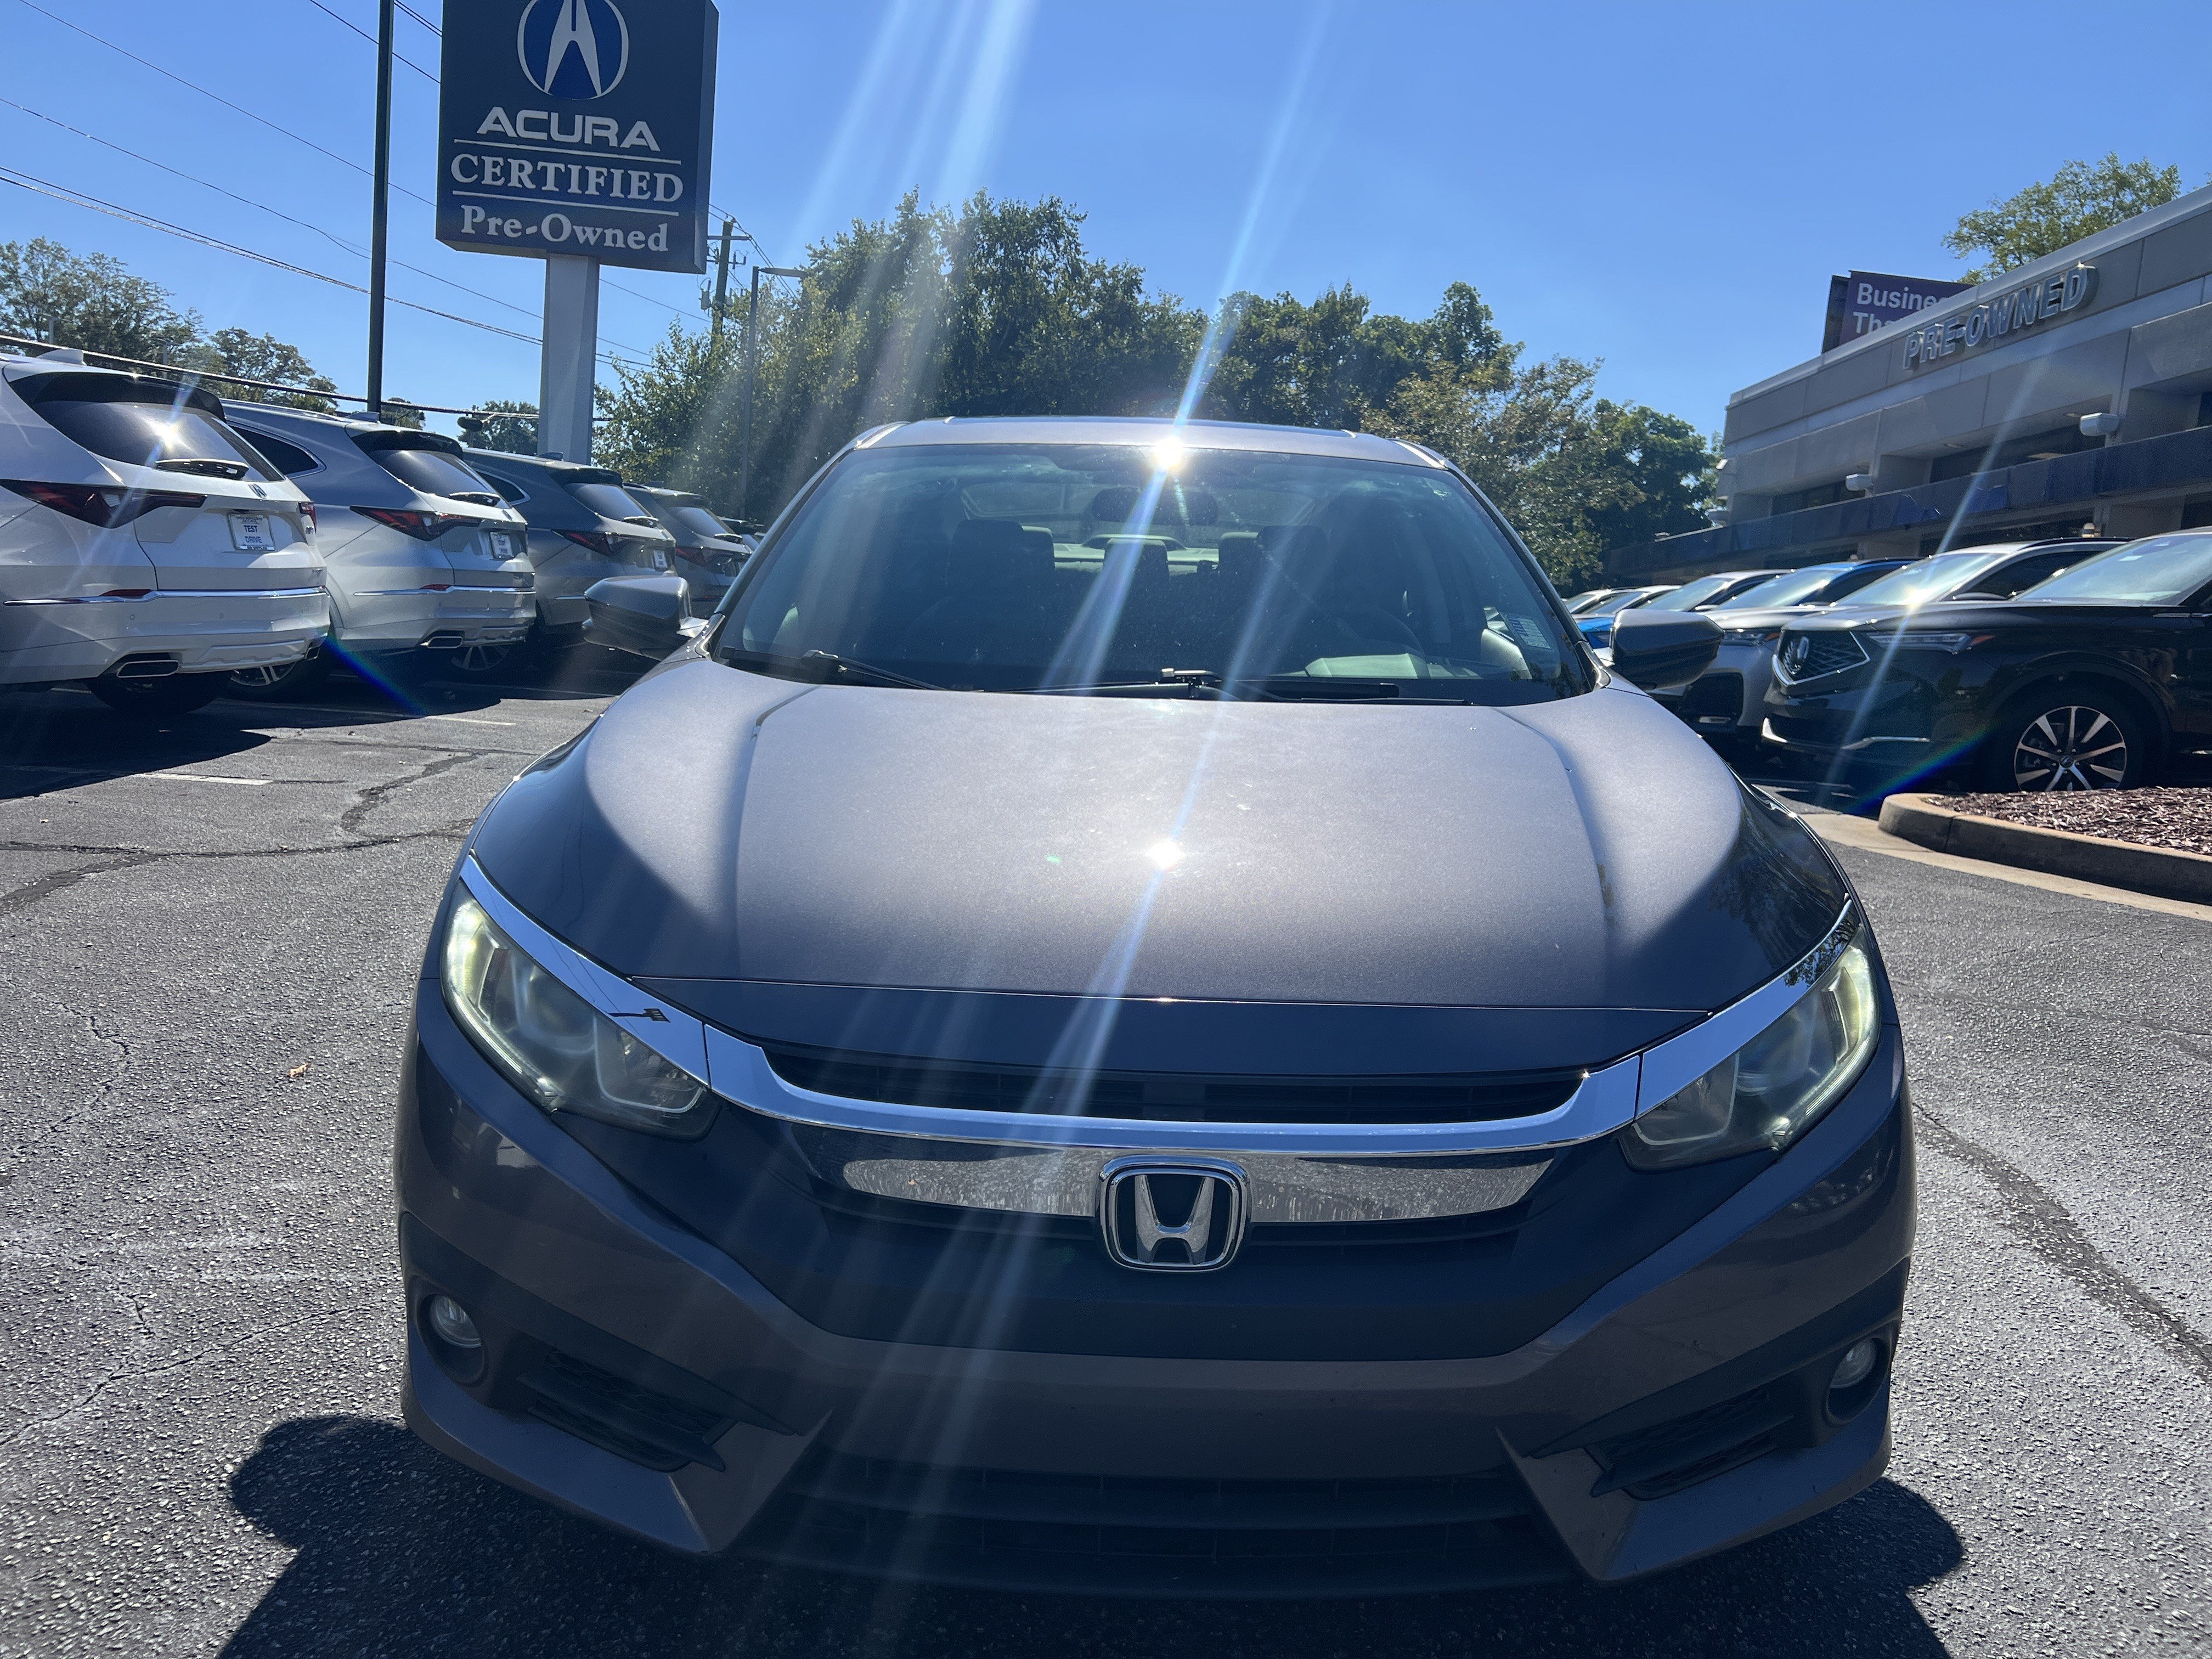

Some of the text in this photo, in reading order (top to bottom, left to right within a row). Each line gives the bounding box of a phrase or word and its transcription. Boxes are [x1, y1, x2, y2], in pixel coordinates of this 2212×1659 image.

[477, 107, 661, 151] ACURA
[451, 153, 684, 202] CERTIFIED
[461, 205, 669, 252] Pre-Owned
[1857, 283, 1949, 311] Busine
[1903, 266, 2090, 369] PRE-OWNED
[1853, 312, 1897, 334] Th
